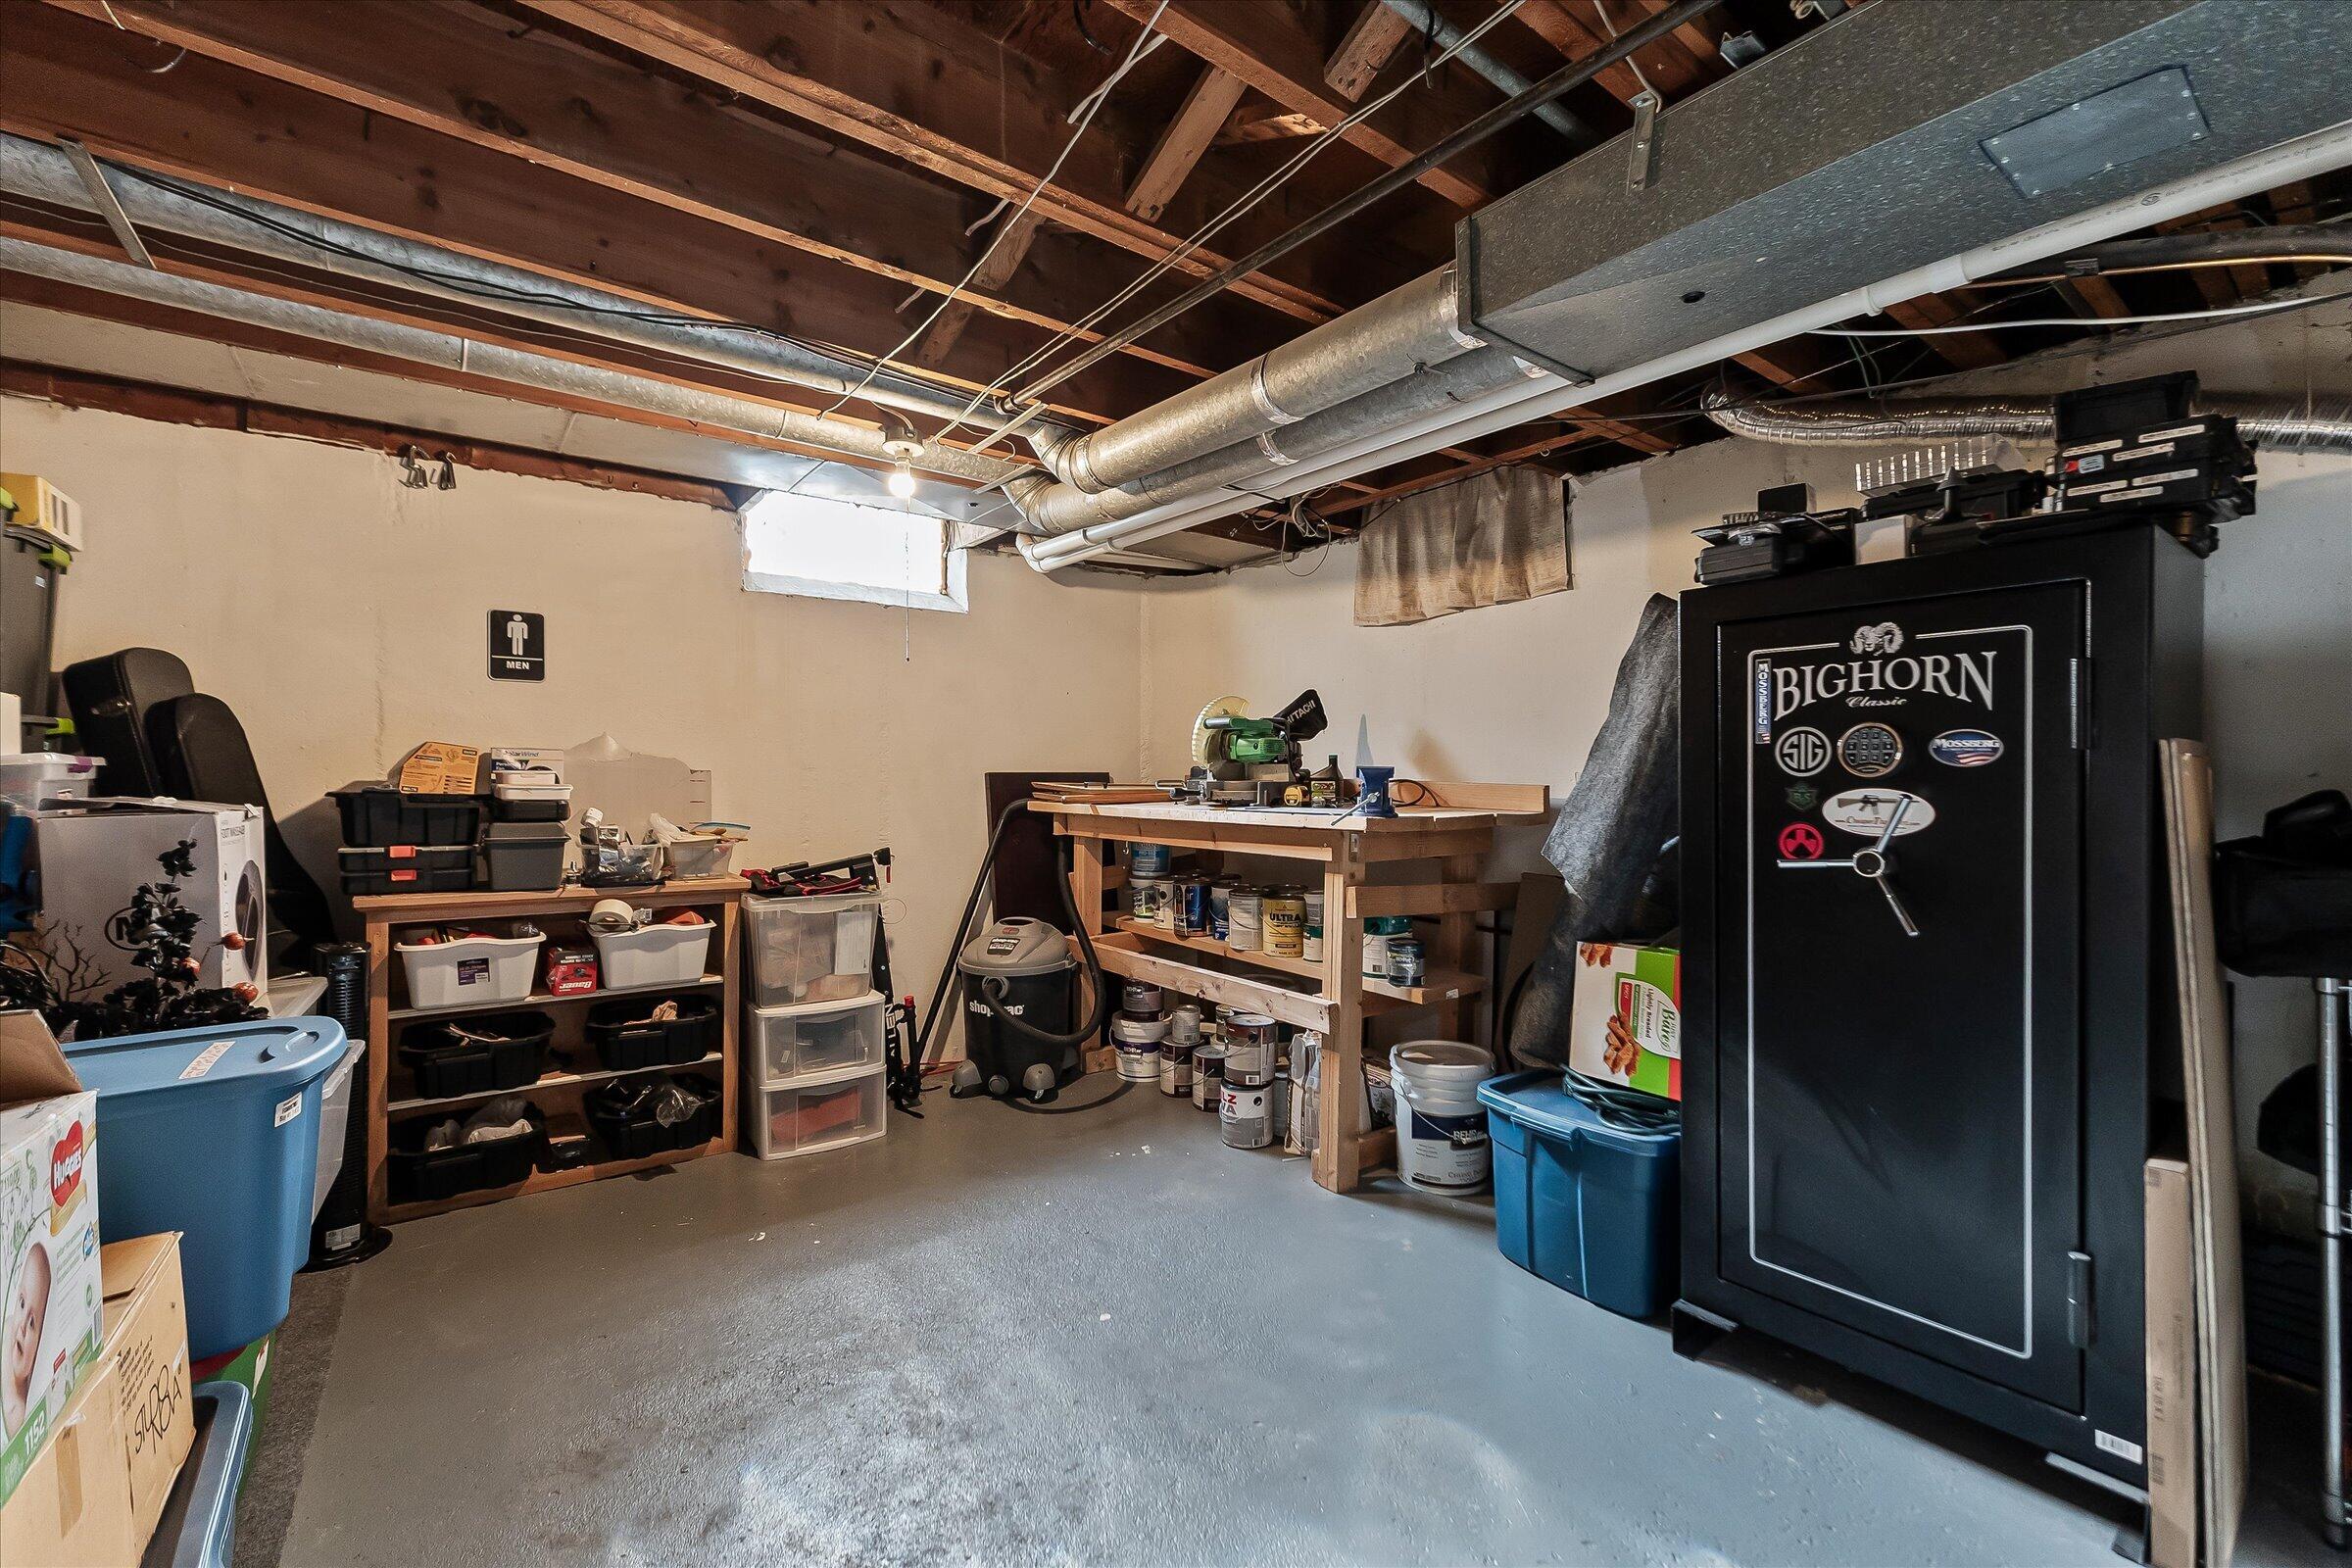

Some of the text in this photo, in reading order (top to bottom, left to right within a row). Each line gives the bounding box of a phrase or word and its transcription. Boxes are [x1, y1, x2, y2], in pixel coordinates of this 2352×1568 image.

[506, 661, 530, 670] MEN
[1757, 663, 1769, 725] MOSSBERG
[1773, 651, 1997, 721] BIGHORN
[1845, 695, 1907, 708] Classic
[1287, 699, 1316, 724] HITACHI
[1783, 734, 1824, 770] SIG
[1269, 912, 1301, 922] ULTRA
[53, 1147, 82, 1191] HUGGIES
[24, 1409, 45, 1456] 1152
